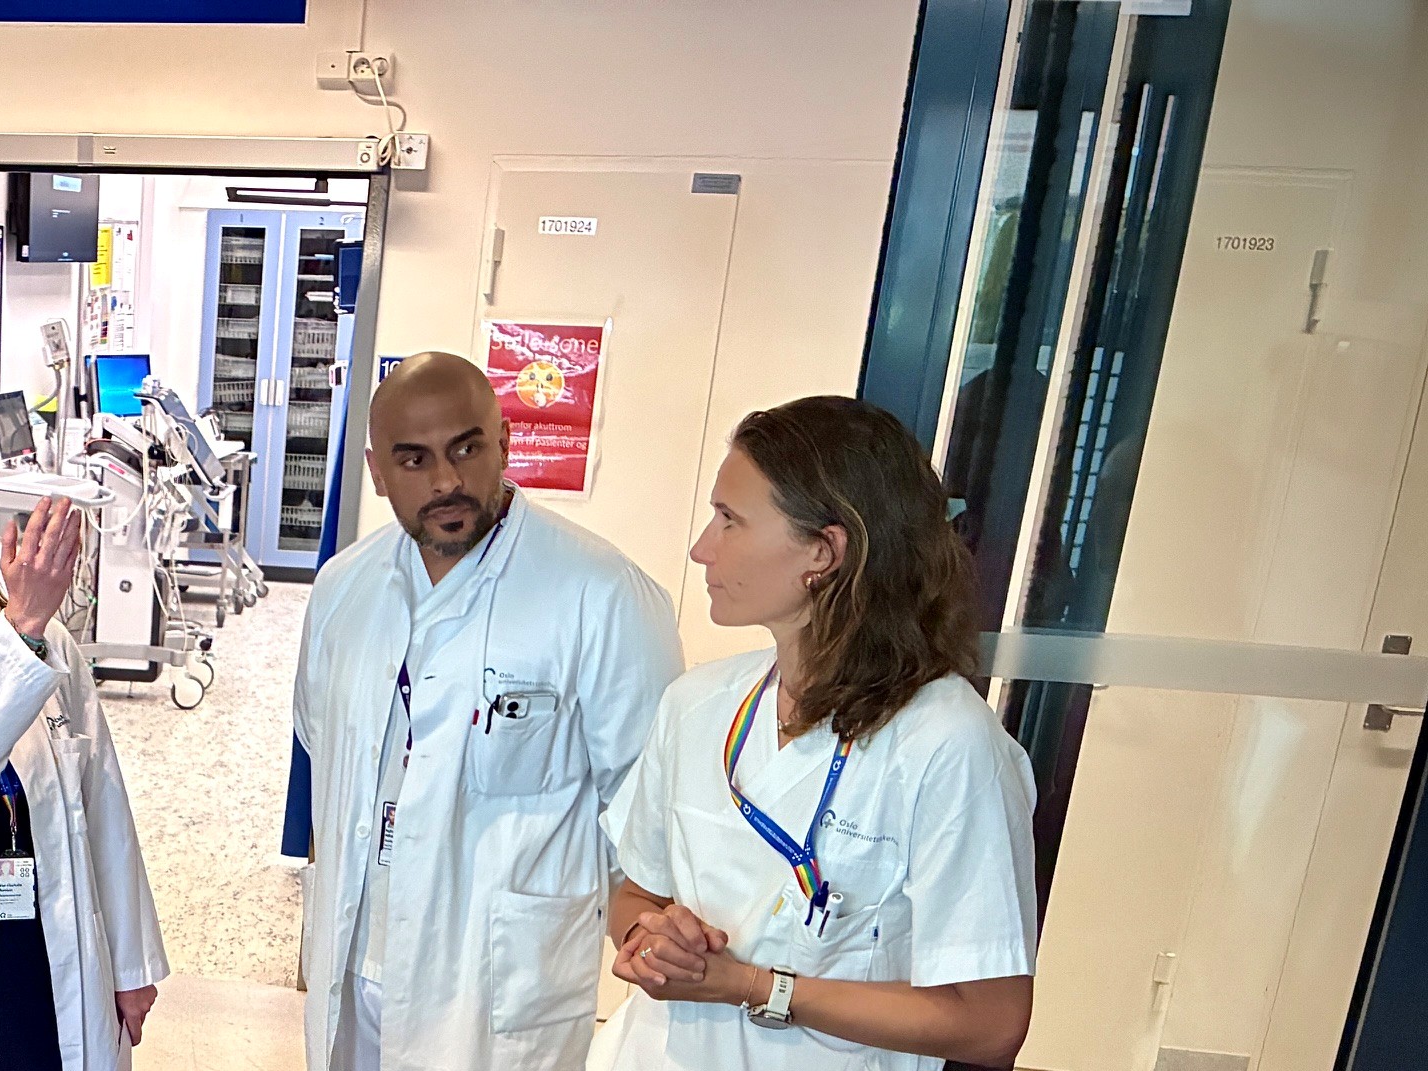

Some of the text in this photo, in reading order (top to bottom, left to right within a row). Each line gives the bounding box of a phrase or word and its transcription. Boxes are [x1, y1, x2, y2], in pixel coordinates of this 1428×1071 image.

[541, 219, 592, 232] 1701924
[1217, 236, 1275, 251] 1701923
[533, 421, 572, 432] akuttrom
[575, 440, 587, 451] og
[839, 819, 859, 830] Oslo
